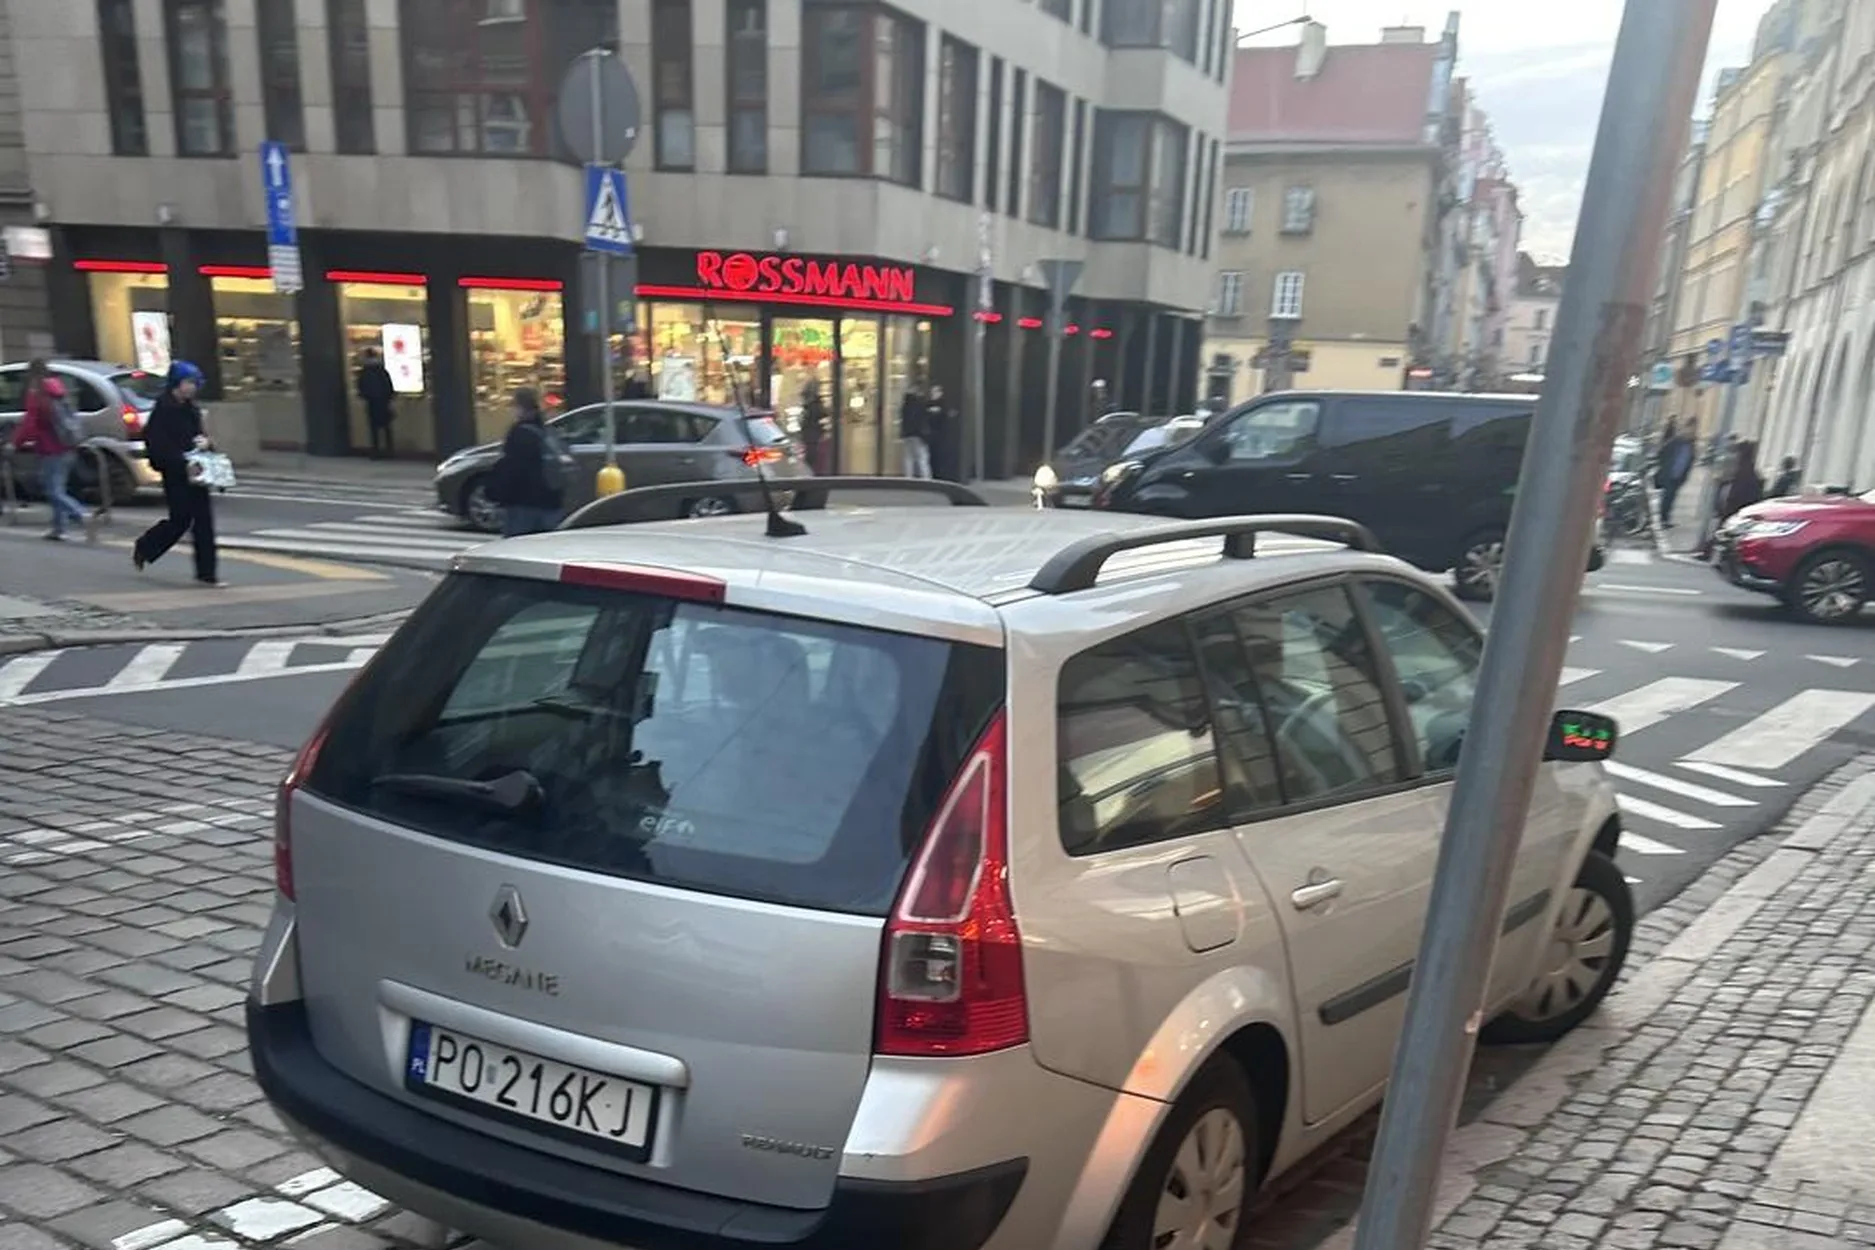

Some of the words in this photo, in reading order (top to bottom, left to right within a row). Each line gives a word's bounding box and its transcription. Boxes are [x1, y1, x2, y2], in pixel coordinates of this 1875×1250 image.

[696, 251, 914, 301] ROSSMANN
[410, 1057, 426, 1075] PL
[433, 1033, 484, 1093] PO
[495, 1055, 633, 1137] 216KJ
[741, 1133, 835, 1160] RENAULT
